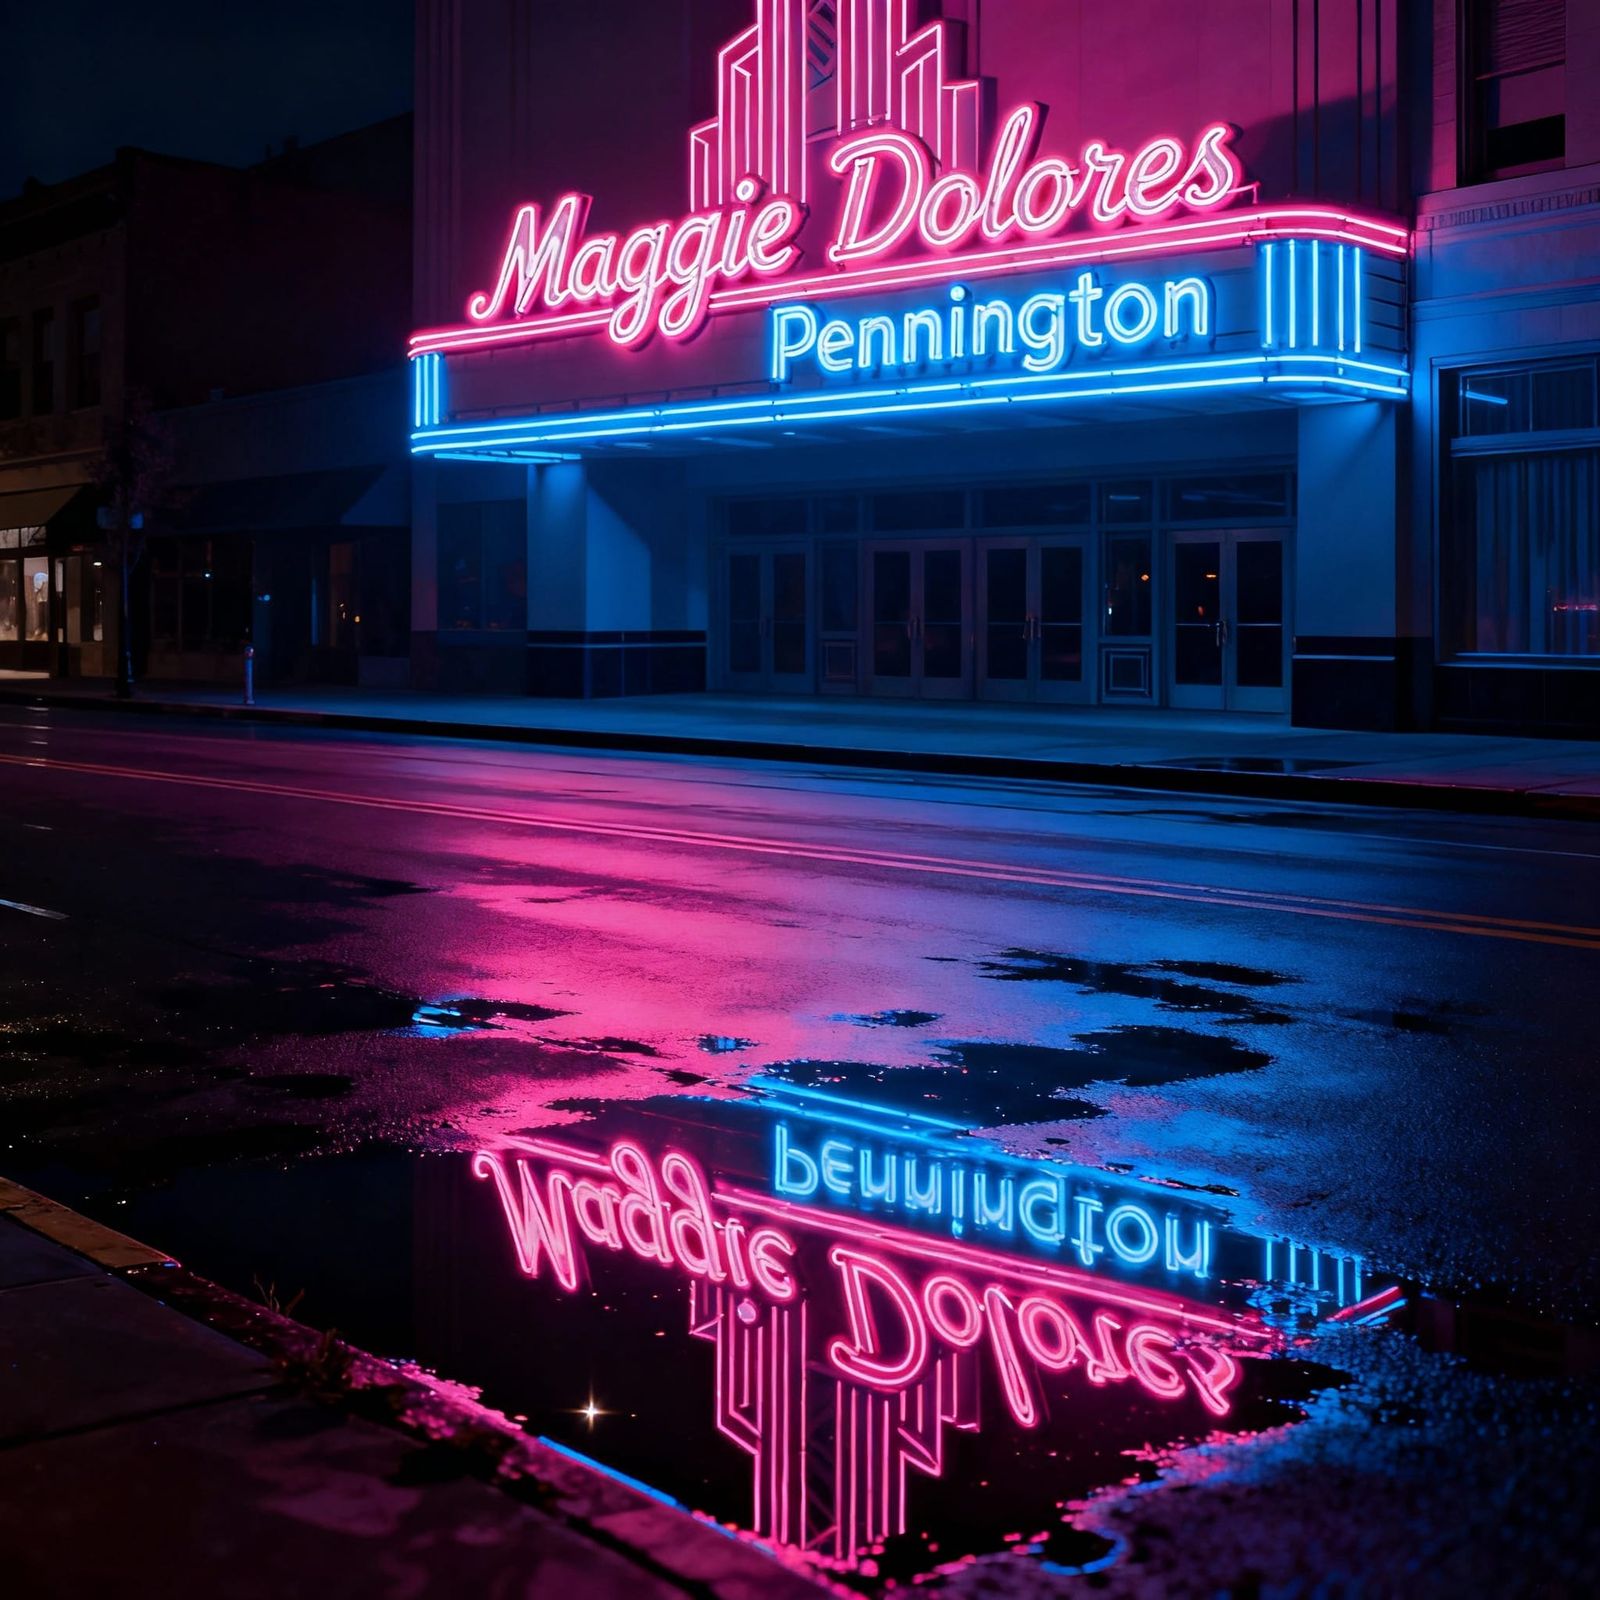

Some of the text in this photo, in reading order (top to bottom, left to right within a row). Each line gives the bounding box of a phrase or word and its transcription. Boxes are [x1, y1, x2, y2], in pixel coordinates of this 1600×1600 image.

[467, 103, 1242, 346] Maggie Dolores
[770, 271, 1212, 381] Pennington
